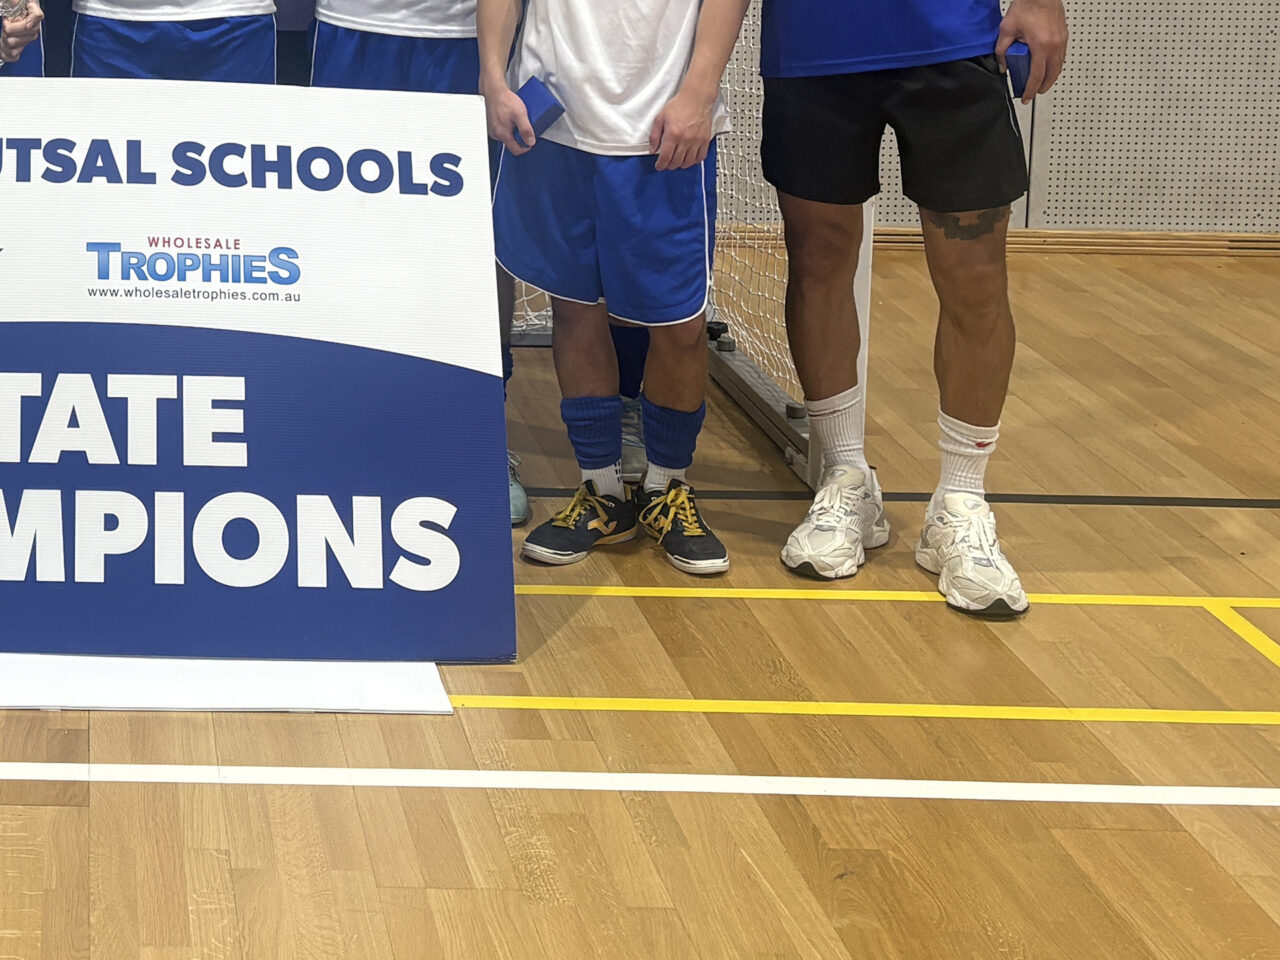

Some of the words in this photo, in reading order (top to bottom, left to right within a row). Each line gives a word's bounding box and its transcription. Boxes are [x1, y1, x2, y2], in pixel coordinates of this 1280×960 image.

[170, 140, 464, 198] SCHOOLS
[147, 235, 241, 250] WHOLESALE
[85, 241, 301, 286] TROPHIES
[87, 286, 301, 303] www.wholesaletrophies.com.au
